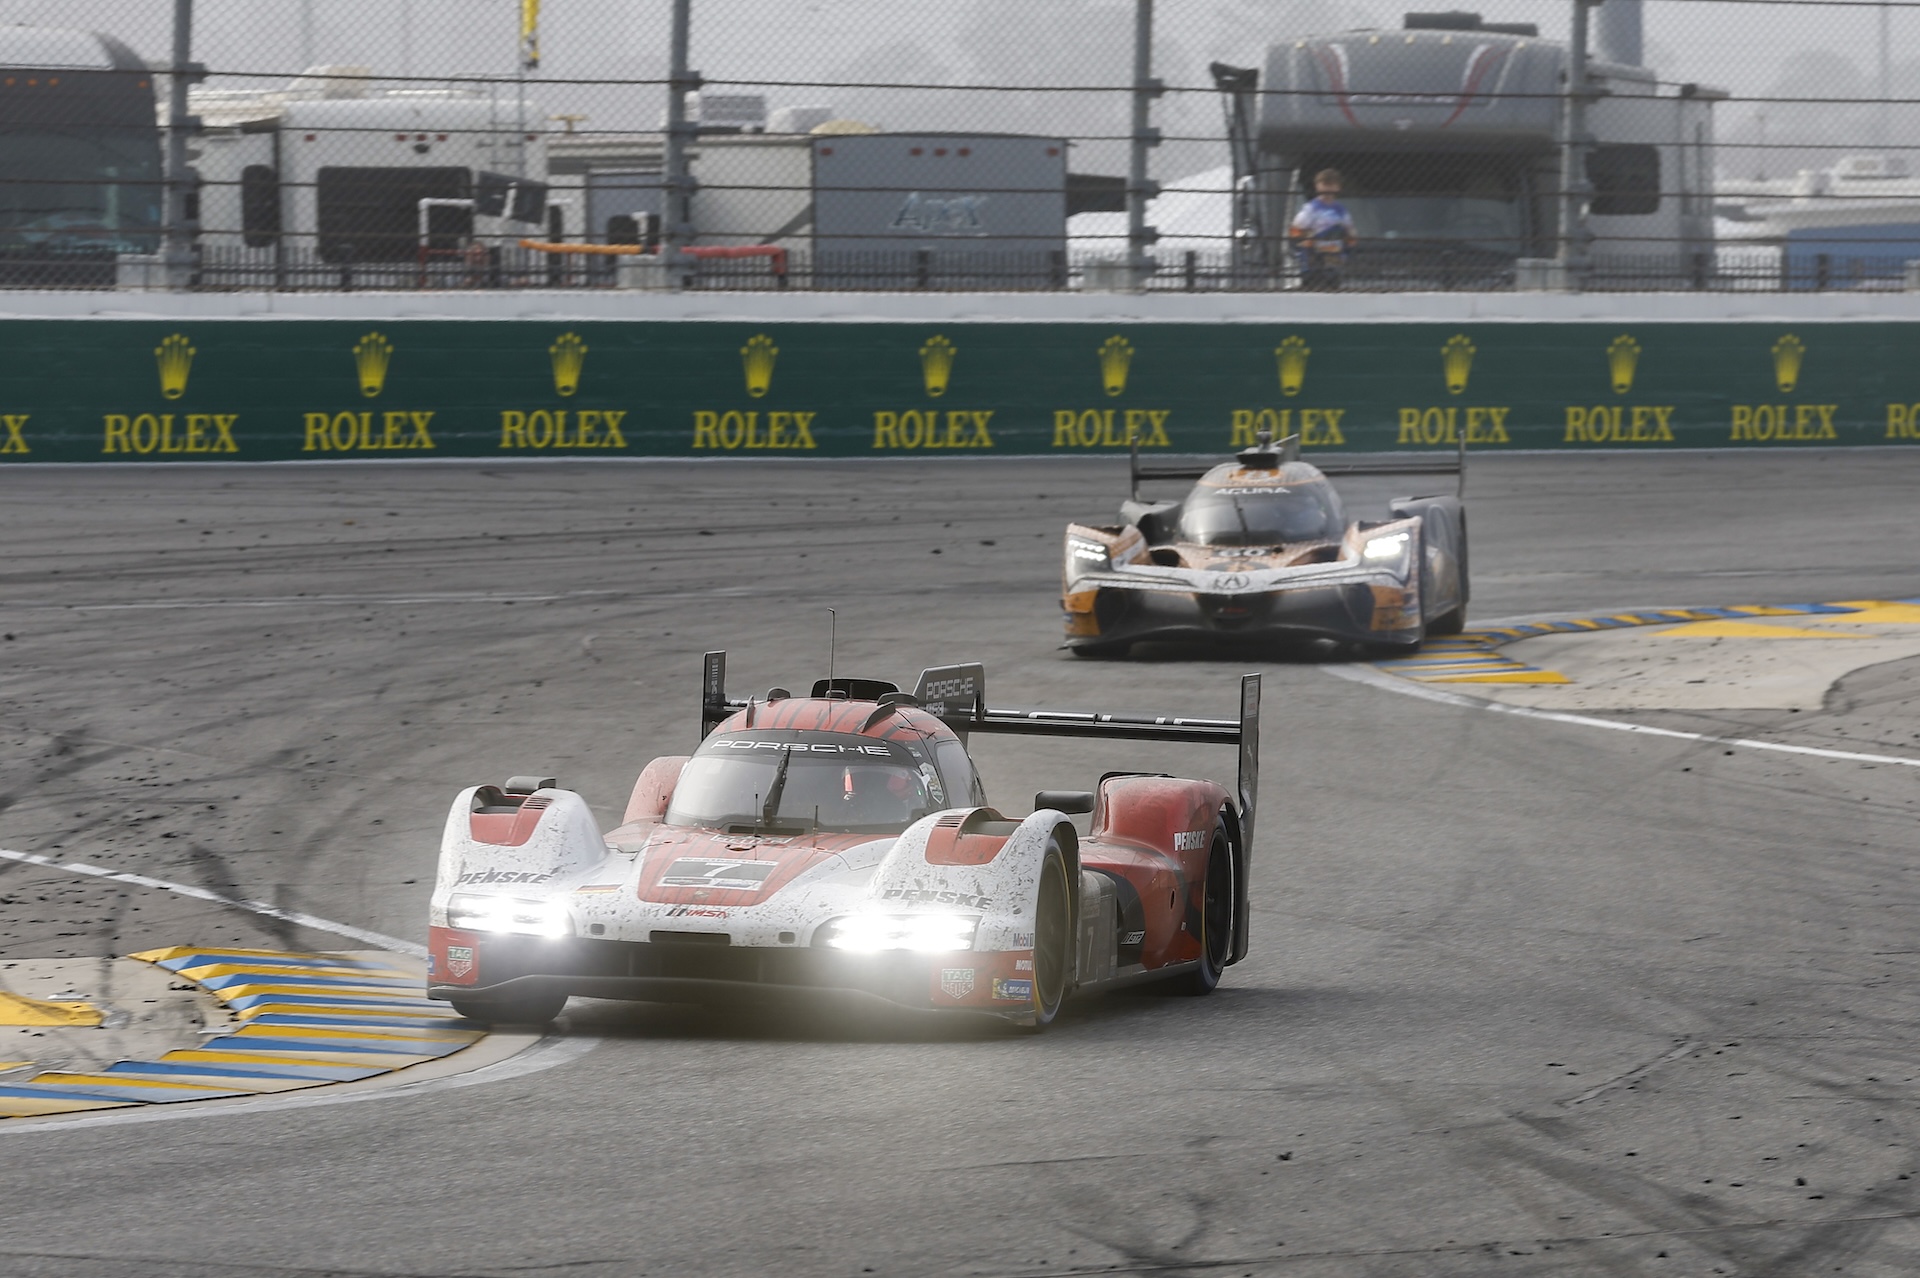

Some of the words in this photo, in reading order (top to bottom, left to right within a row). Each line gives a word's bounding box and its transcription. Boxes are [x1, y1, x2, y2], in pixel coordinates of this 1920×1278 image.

[102, 413, 239, 454] ROLEX
[302, 411, 435, 451] ROLEX
[499, 409, 627, 449] ROLEX
[692, 410, 817, 449] ROLEX
[873, 409, 994, 449] ROLEX
[1052, 409, 1170, 447] ROLEX
[1230, 408, 1345, 446] ROLEX
[1398, 407, 1510, 444] ROLEX
[1564, 405, 1674, 442] ROLEX
[1730, 404, 1838, 441] ROLEX
[1213, 487, 1291, 495] ACURA
[1218, 548, 1267, 557] 60
[926, 677, 974, 701] PORSCHE
[711, 740, 892, 757] PORSCHE
[1174, 830, 1206, 851] PENSKE
[455, 871, 553, 885] PENSKE
[703, 862, 742, 877] 7
[881, 889, 994, 910] PENSKE
[449, 948, 471, 959] TAG
[944, 970, 972, 980] TAG
[943, 982, 972, 997] HEUER
